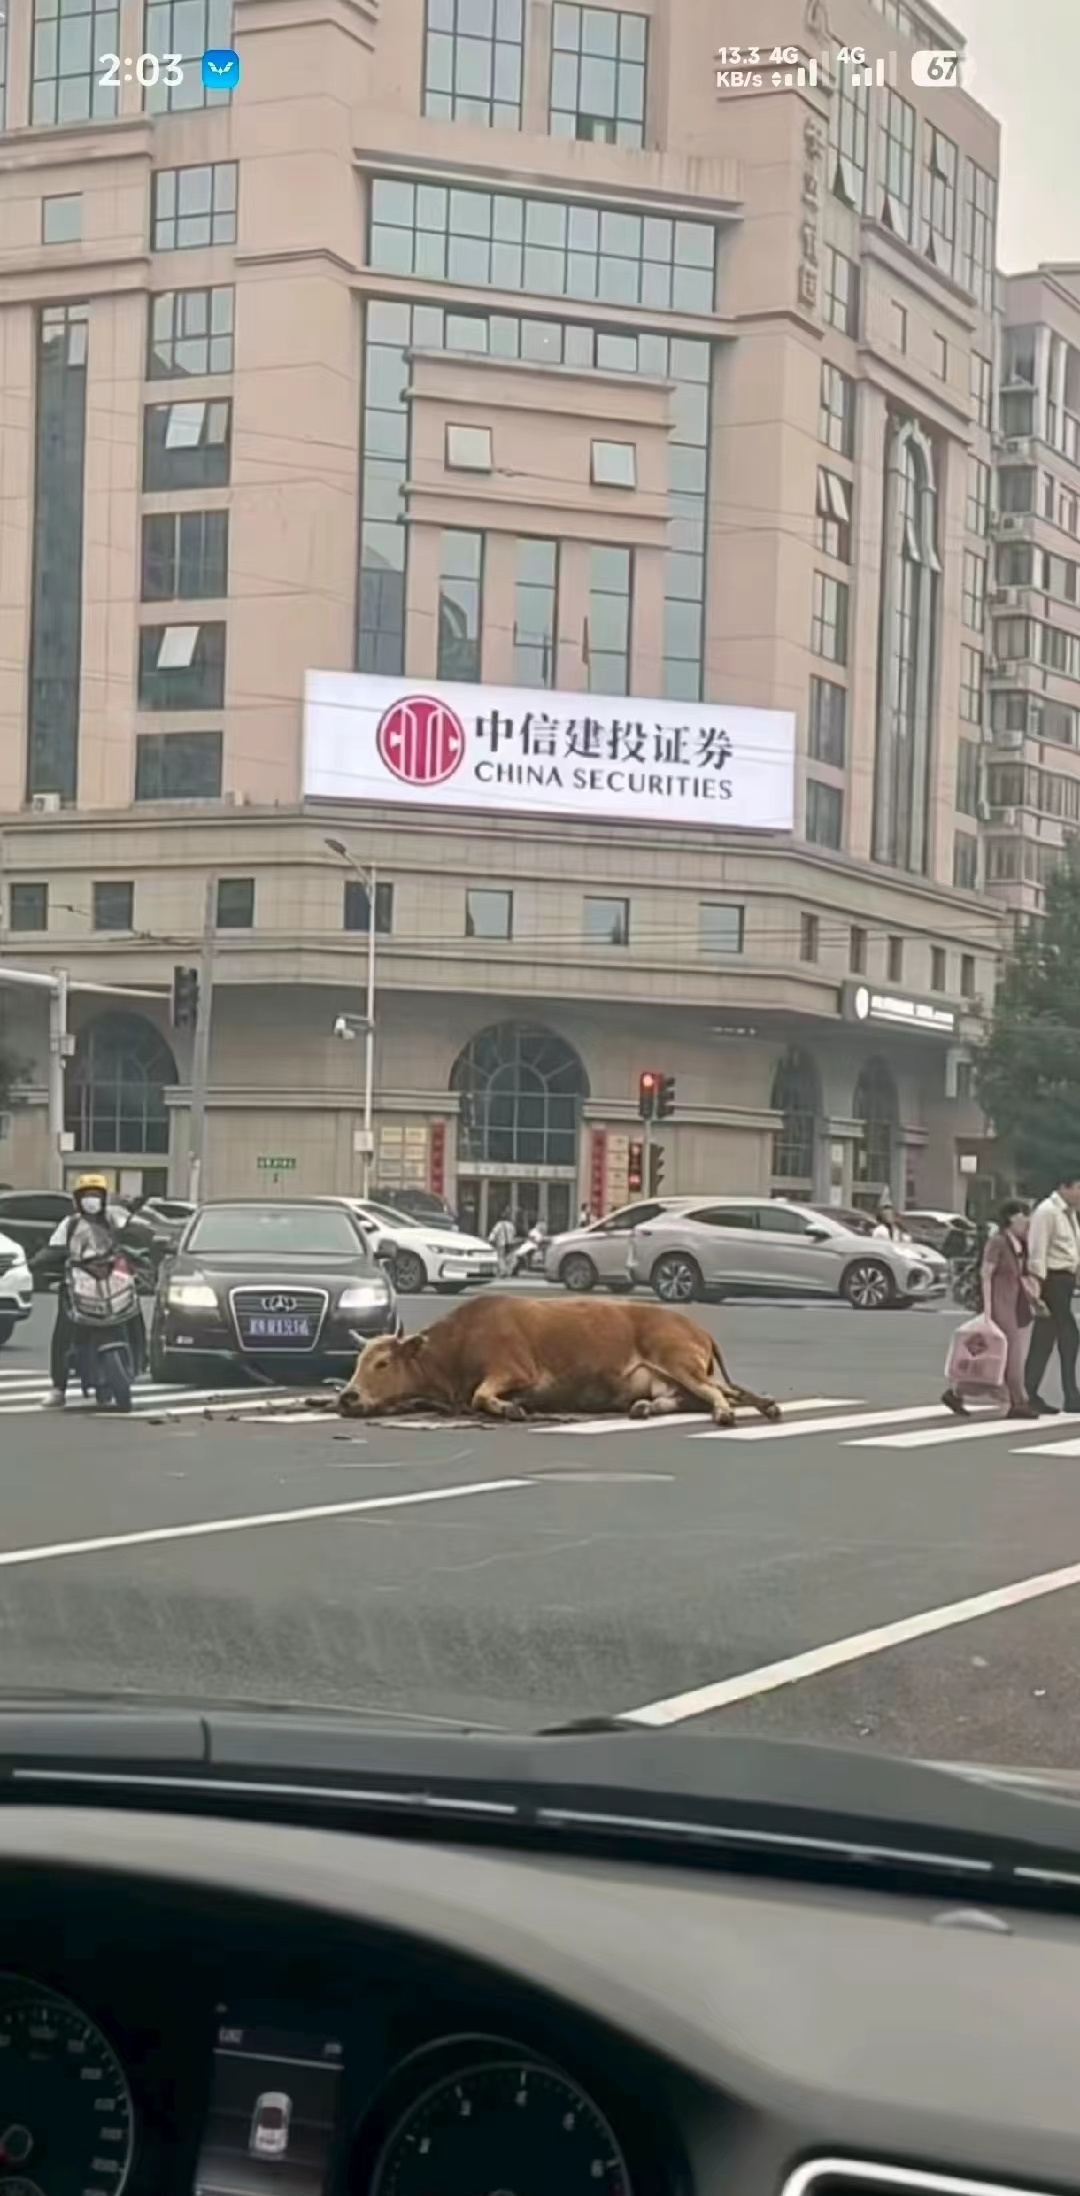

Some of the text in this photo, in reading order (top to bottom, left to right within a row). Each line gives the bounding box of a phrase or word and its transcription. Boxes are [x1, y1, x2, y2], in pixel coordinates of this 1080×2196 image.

[475, 709, 733, 770] 中信建投证券
[474, 760, 733, 800] CHINA SECURITIES
